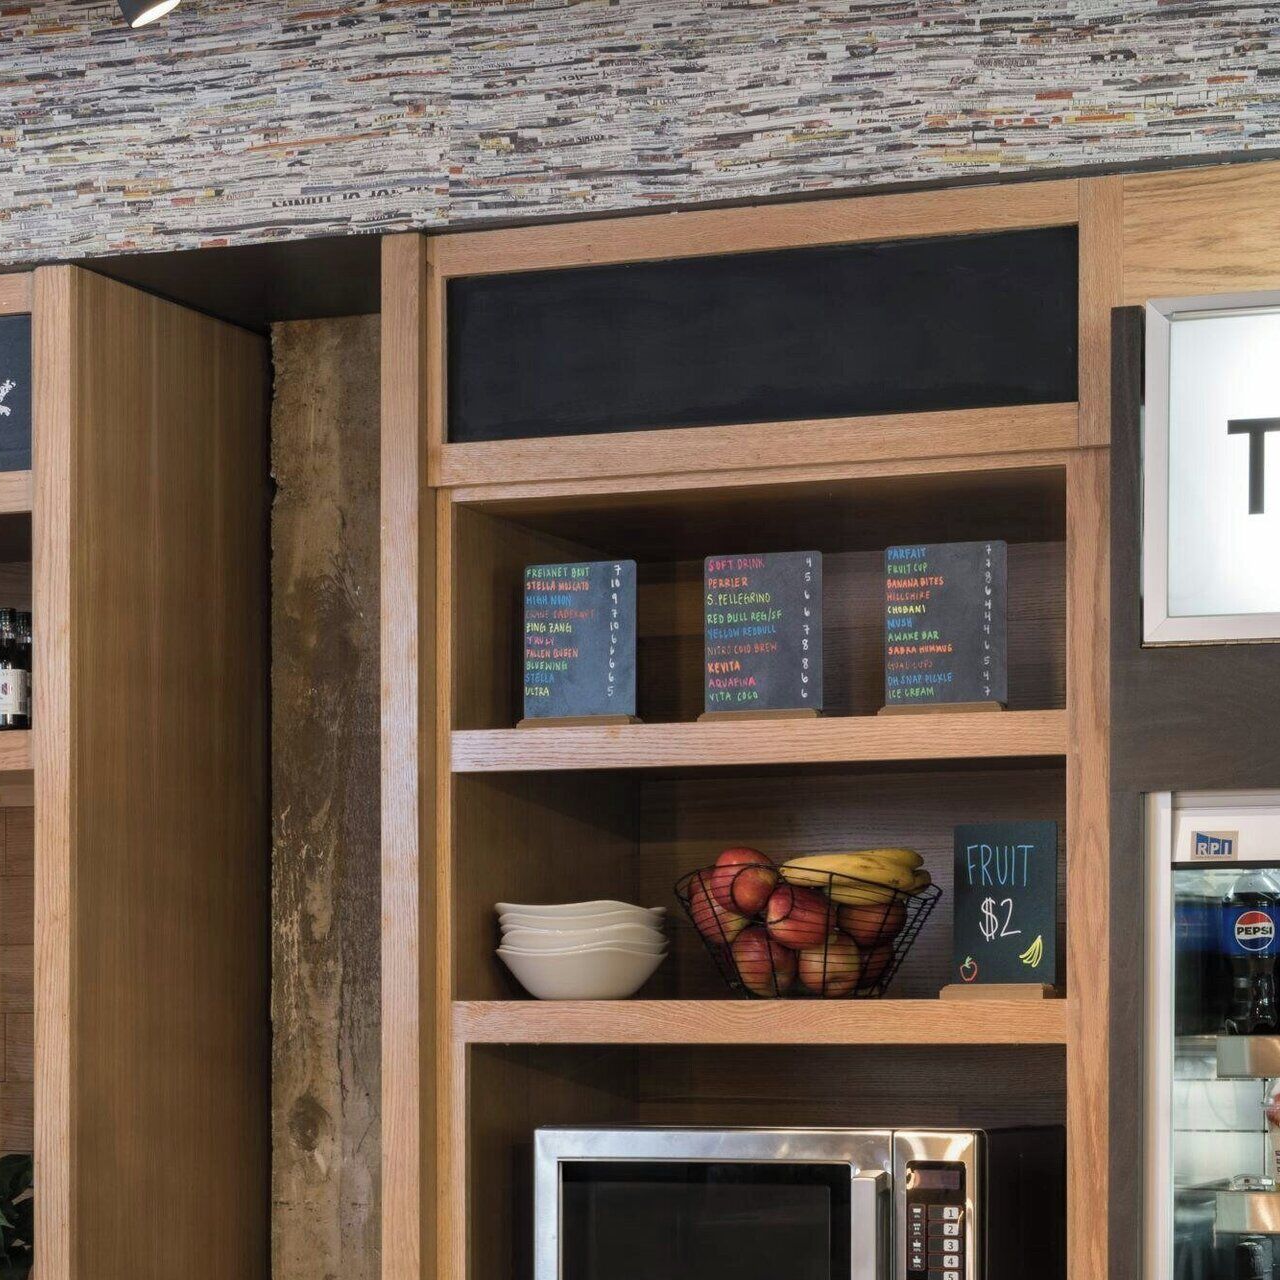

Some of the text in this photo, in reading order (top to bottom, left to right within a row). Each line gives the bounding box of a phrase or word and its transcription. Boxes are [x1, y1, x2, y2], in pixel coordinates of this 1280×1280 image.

[709, 577, 748, 589] PERRIER
[887, 576, 944, 589] BANANA BITES
[888, 604, 926, 614] CHOBANI
[707, 614, 724, 624] RED
[727, 612, 748, 623] BULL
[802, 639, 808, 650] 8
[708, 658, 808, 673] KEVITA 8
[709, 677, 756, 688] AQUAFINA
[904, 687, 934, 697] CREAM
[1198, 842, 1232, 855] RPI
[966, 843, 1034, 889] FRUIT
[979, 897, 1021, 942] $2
[1236, 925, 1273, 936] PEPSI
